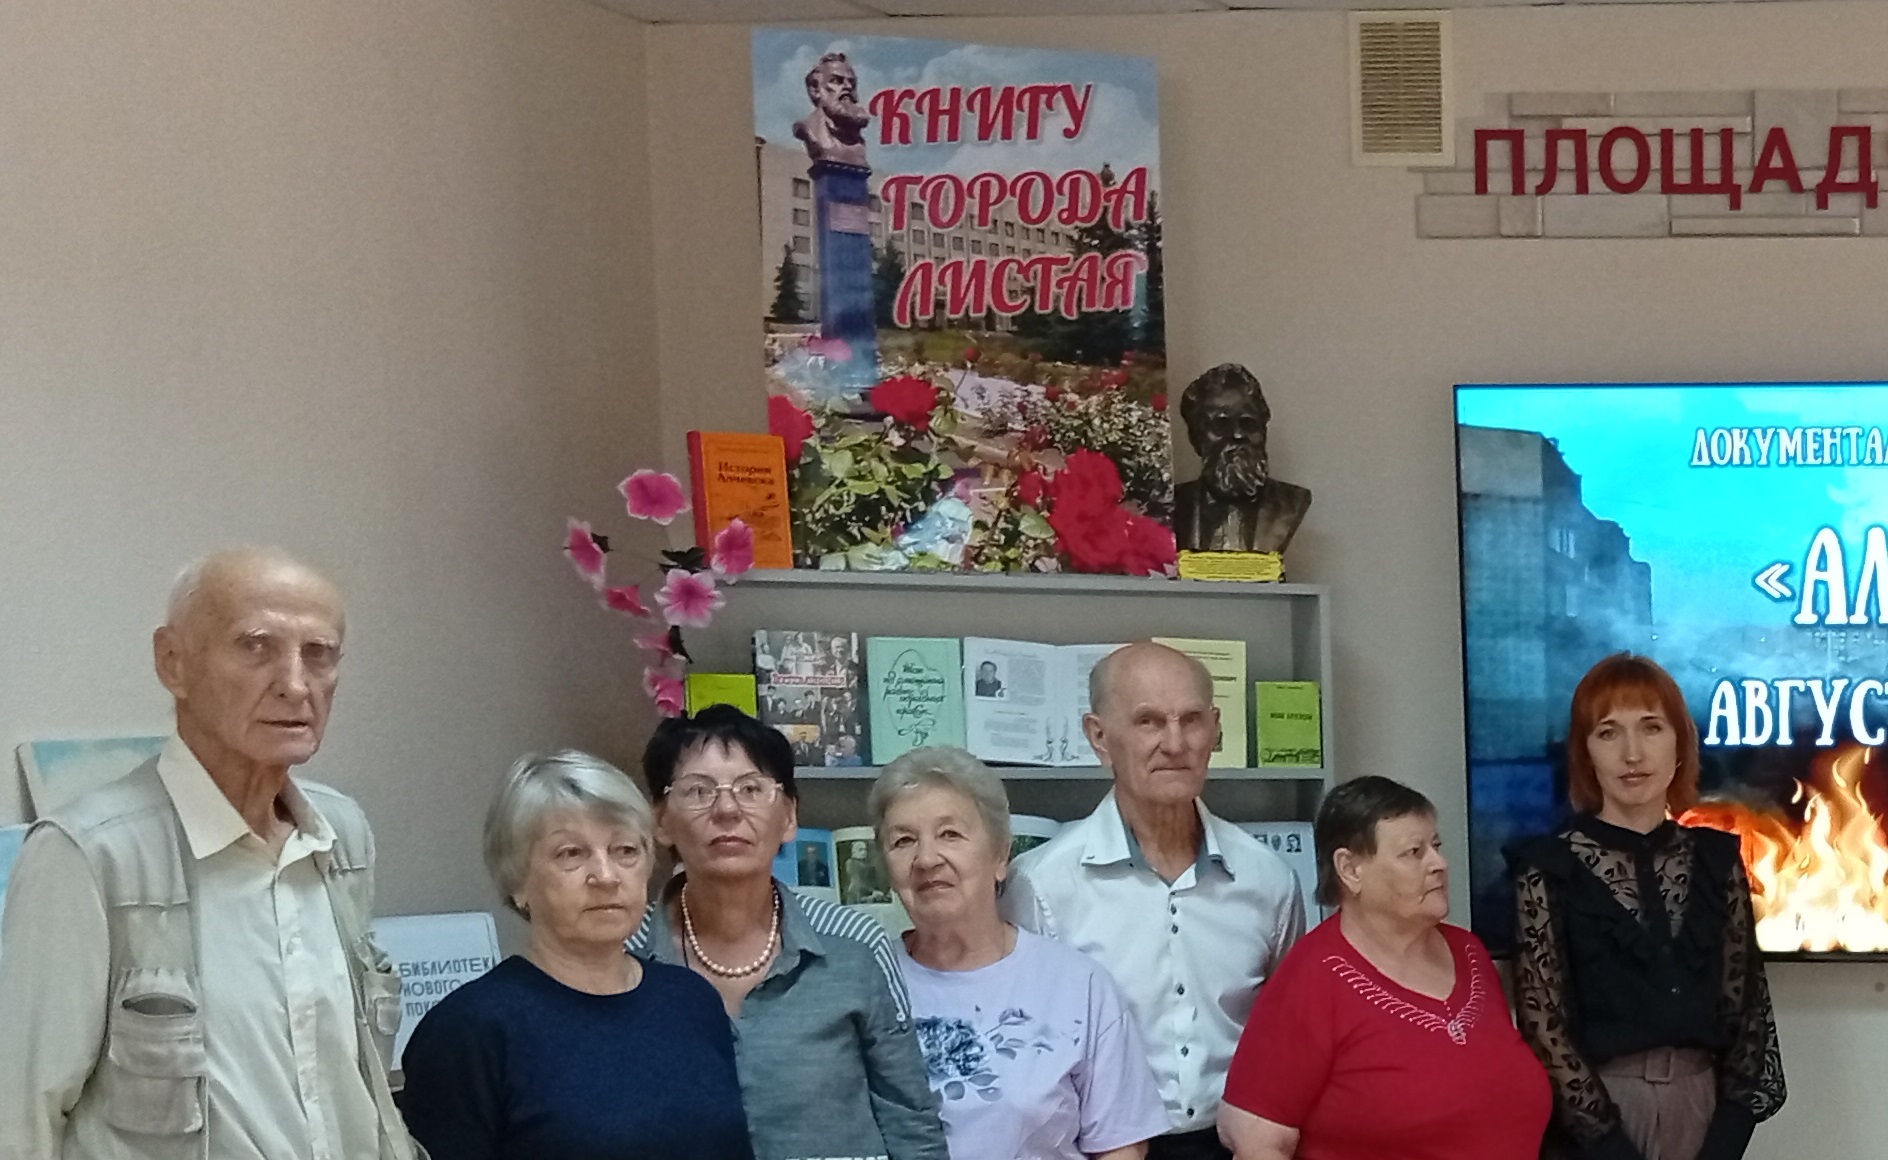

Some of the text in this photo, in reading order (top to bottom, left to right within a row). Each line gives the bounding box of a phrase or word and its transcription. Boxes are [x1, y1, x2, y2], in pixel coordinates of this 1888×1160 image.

[869, 83, 1092, 145] КНИГУ
[881, 166, 1148, 231] ГОРОДА
[895, 252, 1144, 325] ЛИСТАЯ
